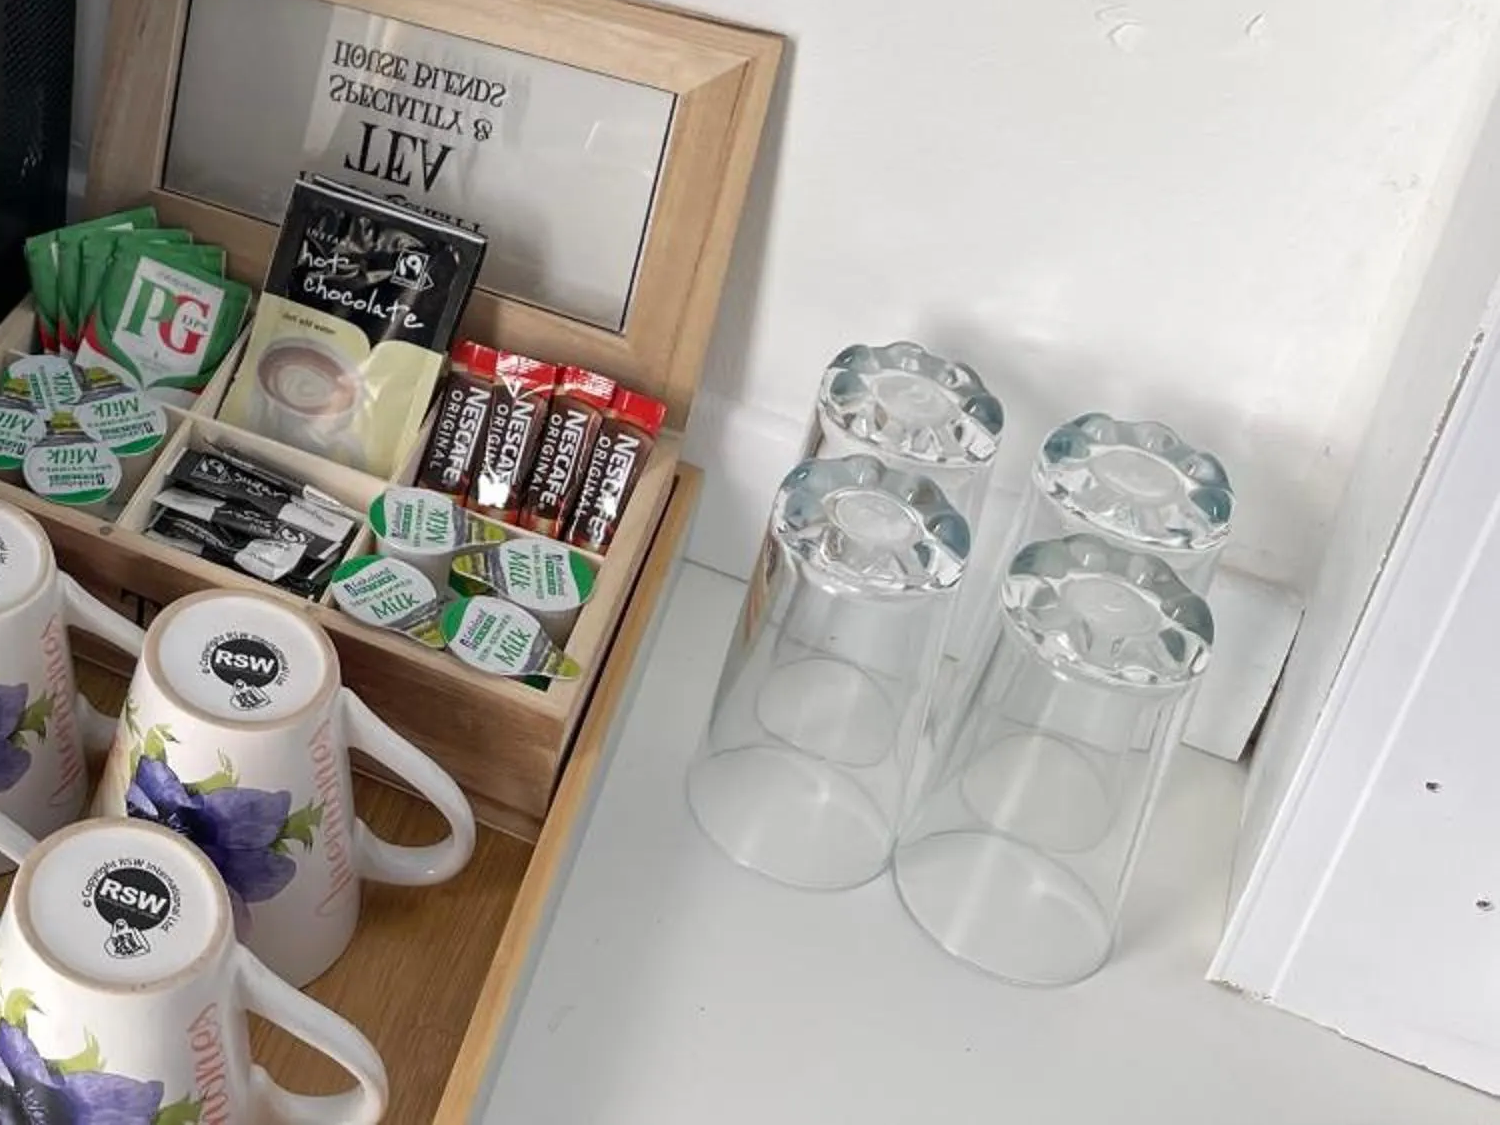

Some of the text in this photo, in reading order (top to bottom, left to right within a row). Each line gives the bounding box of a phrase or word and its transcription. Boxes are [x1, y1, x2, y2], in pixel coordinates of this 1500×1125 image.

[298, 239, 349, 274] hot
[122, 276, 211, 356] PG
[303, 274, 424, 328] chocolate
[91, 397, 139, 419] Milk
[430, 390, 464, 469] ORIGINAL
[49, 447, 97, 465] Milk
[529, 414, 562, 491] ORIGINAL
[425, 507, 449, 545] Milk
[508, 549, 531, 591] Milk
[371, 591, 421, 620] Milk
[215, 649, 275, 674] RSW
[493, 627, 532, 667] Milk
[100, 878, 167, 914] RSW
